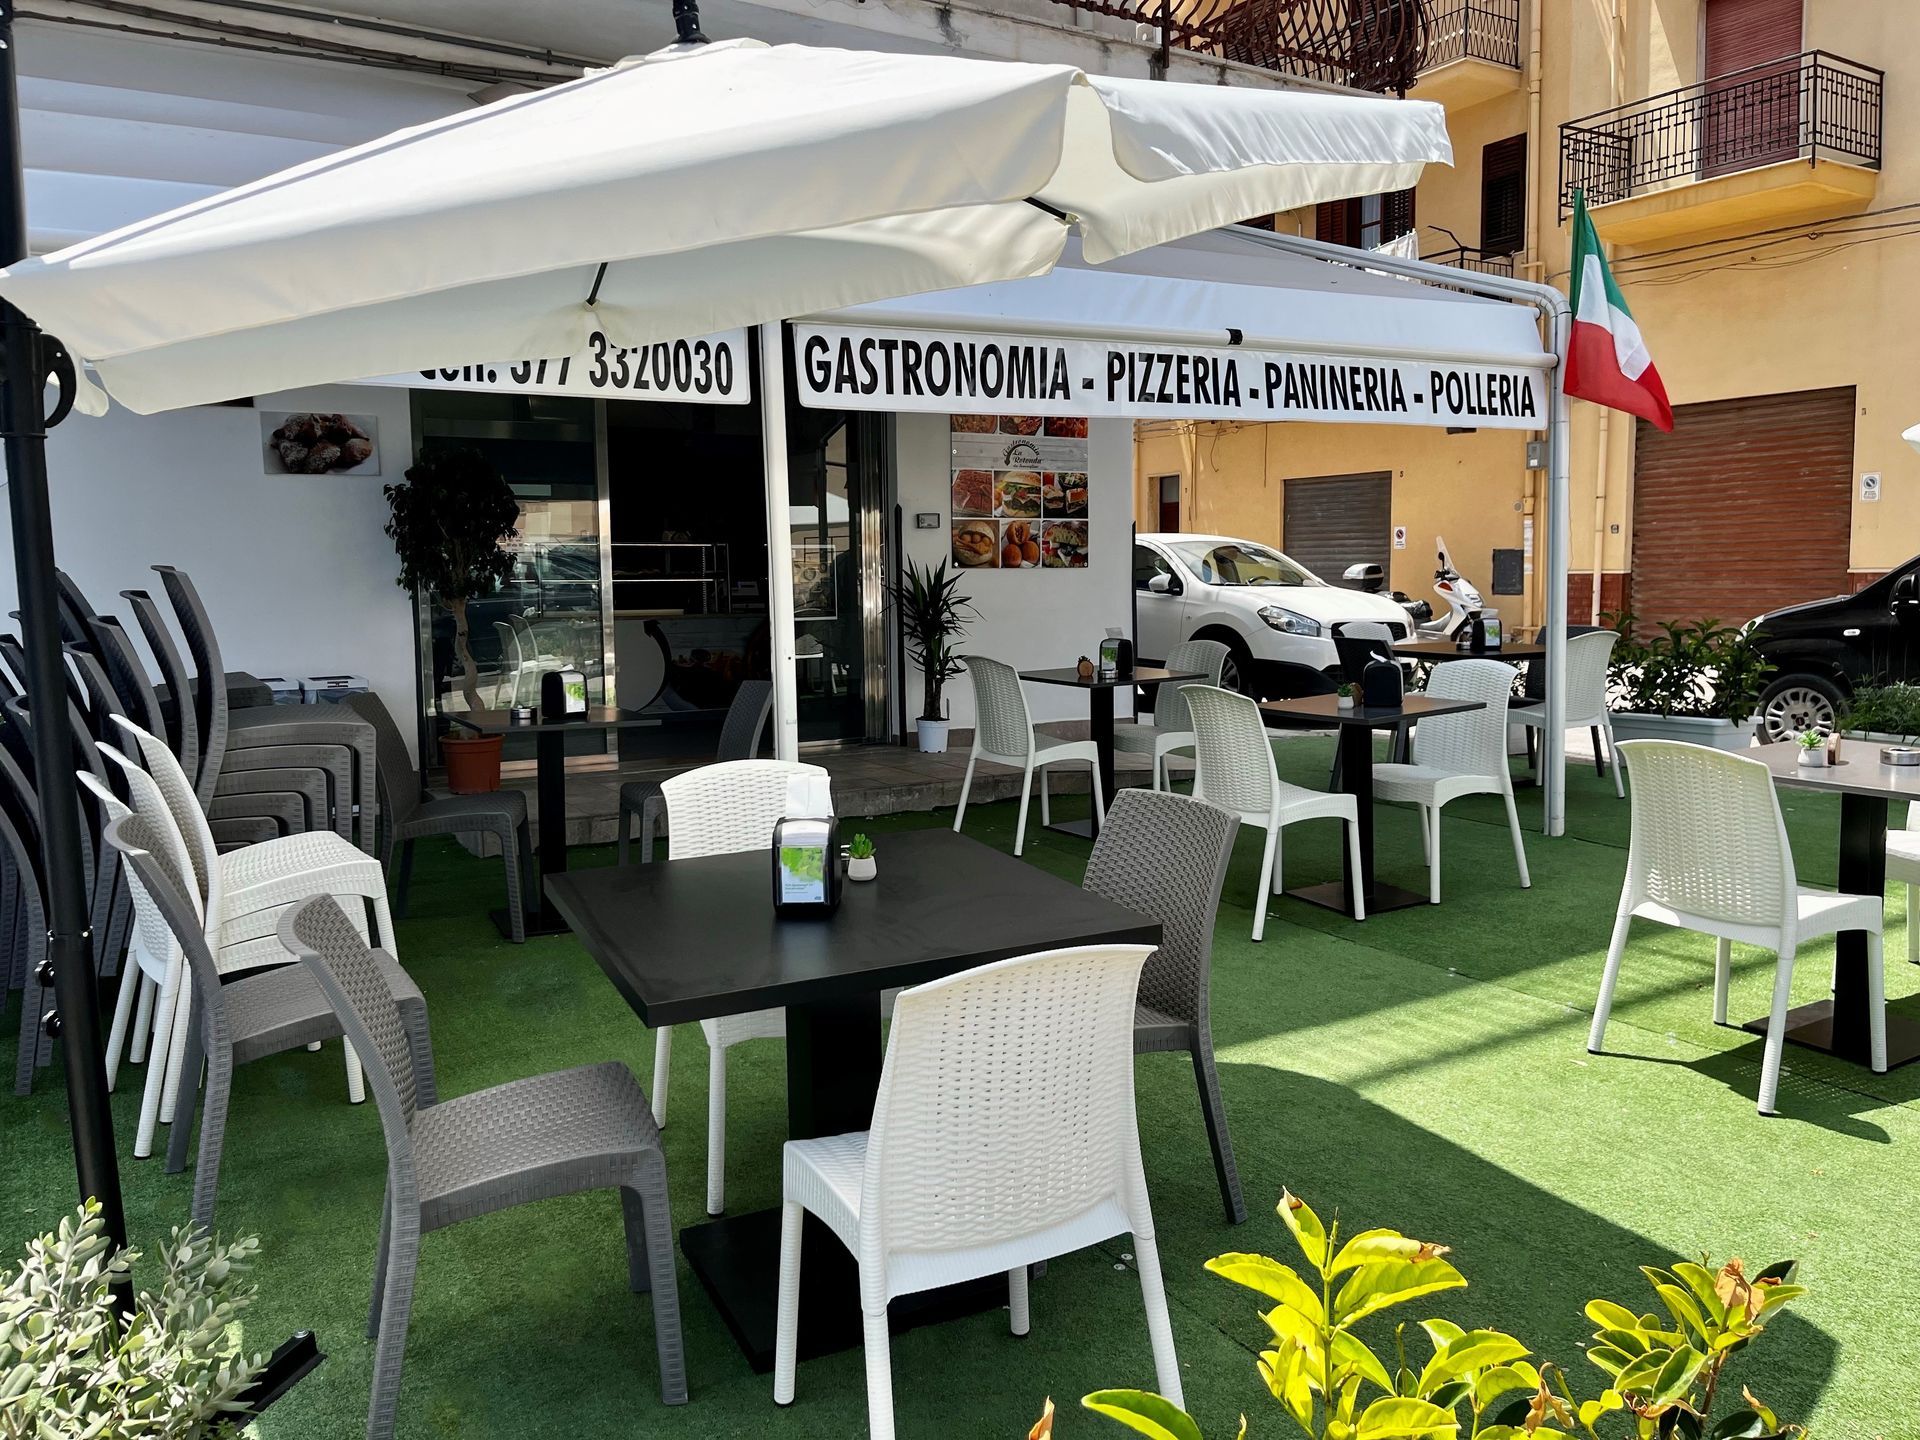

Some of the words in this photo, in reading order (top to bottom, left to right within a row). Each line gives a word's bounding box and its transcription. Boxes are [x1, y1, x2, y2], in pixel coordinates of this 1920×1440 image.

[589, 331, 733, 395] 3320030
[804, 334, 1071, 400] GASTRONOMIA
[1107, 350, 1241, 407] PIZZERIA
[1264, 362, 1408, 413] PANINERIA
[1430, 370, 1536, 417] POLLERIA
